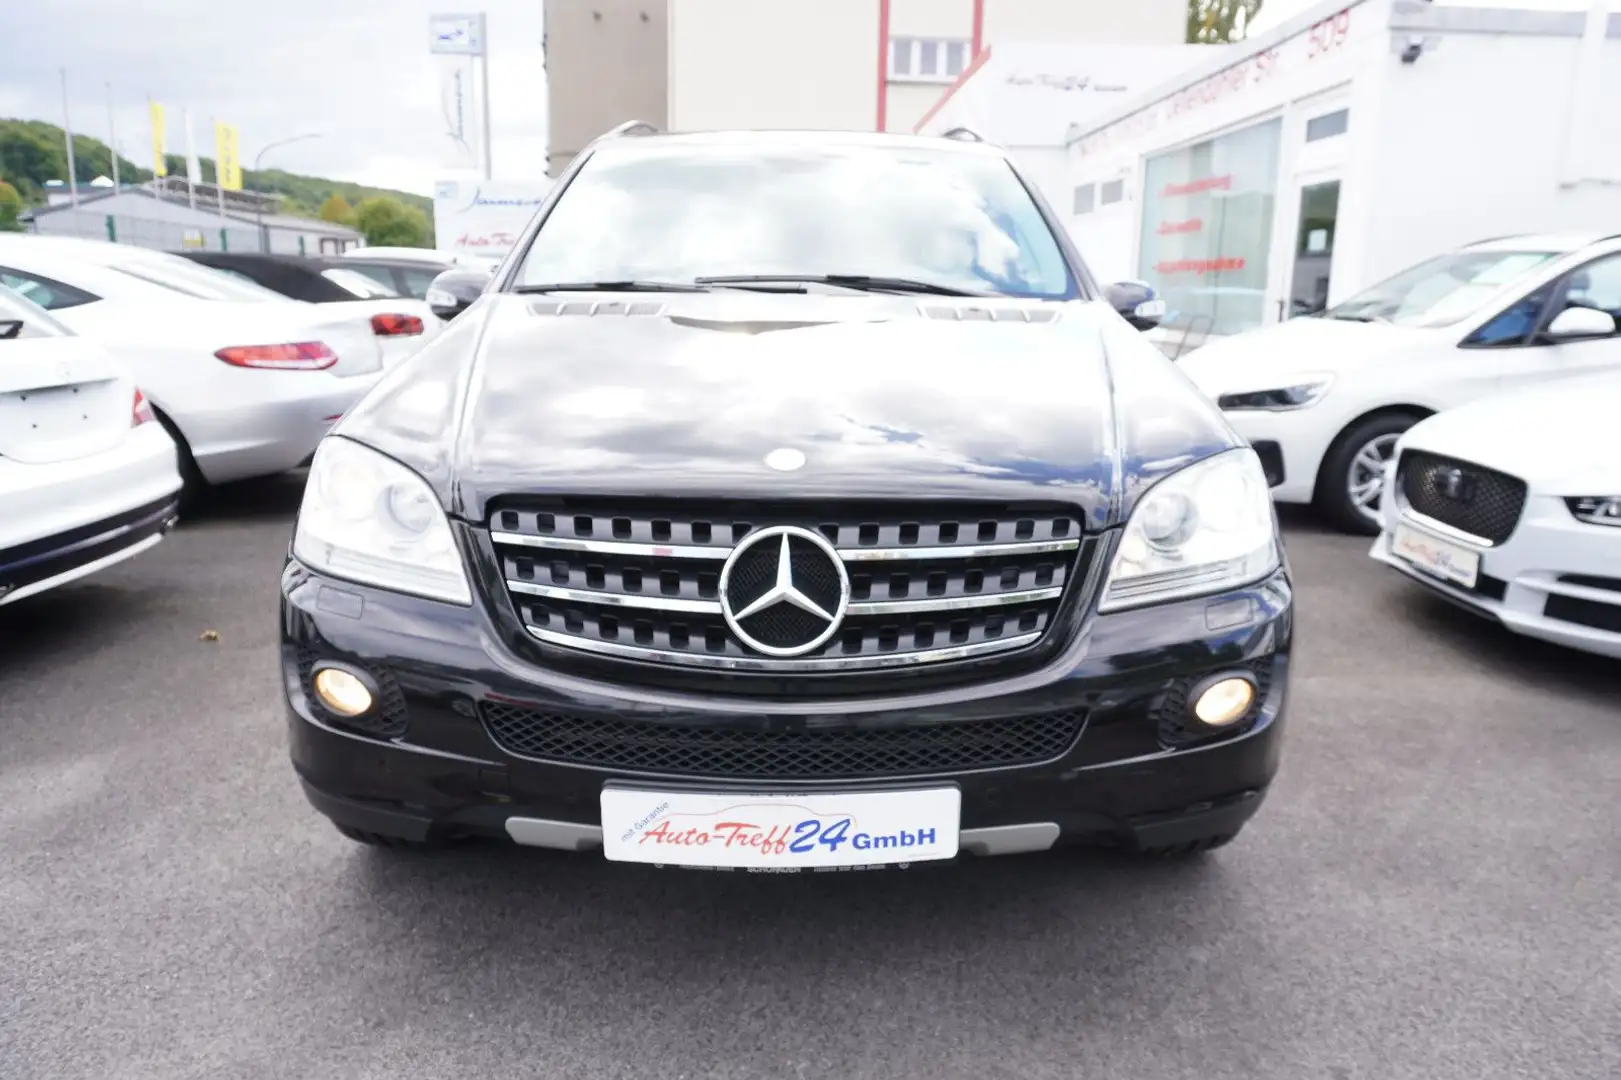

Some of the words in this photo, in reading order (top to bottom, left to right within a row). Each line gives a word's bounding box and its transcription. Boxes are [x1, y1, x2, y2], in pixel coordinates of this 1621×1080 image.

[1308, 7, 1350, 59] 509
[621, 827, 635, 843] mit
[634, 801, 670, 831] Garantie
[852, 827, 936, 850] GmbH
